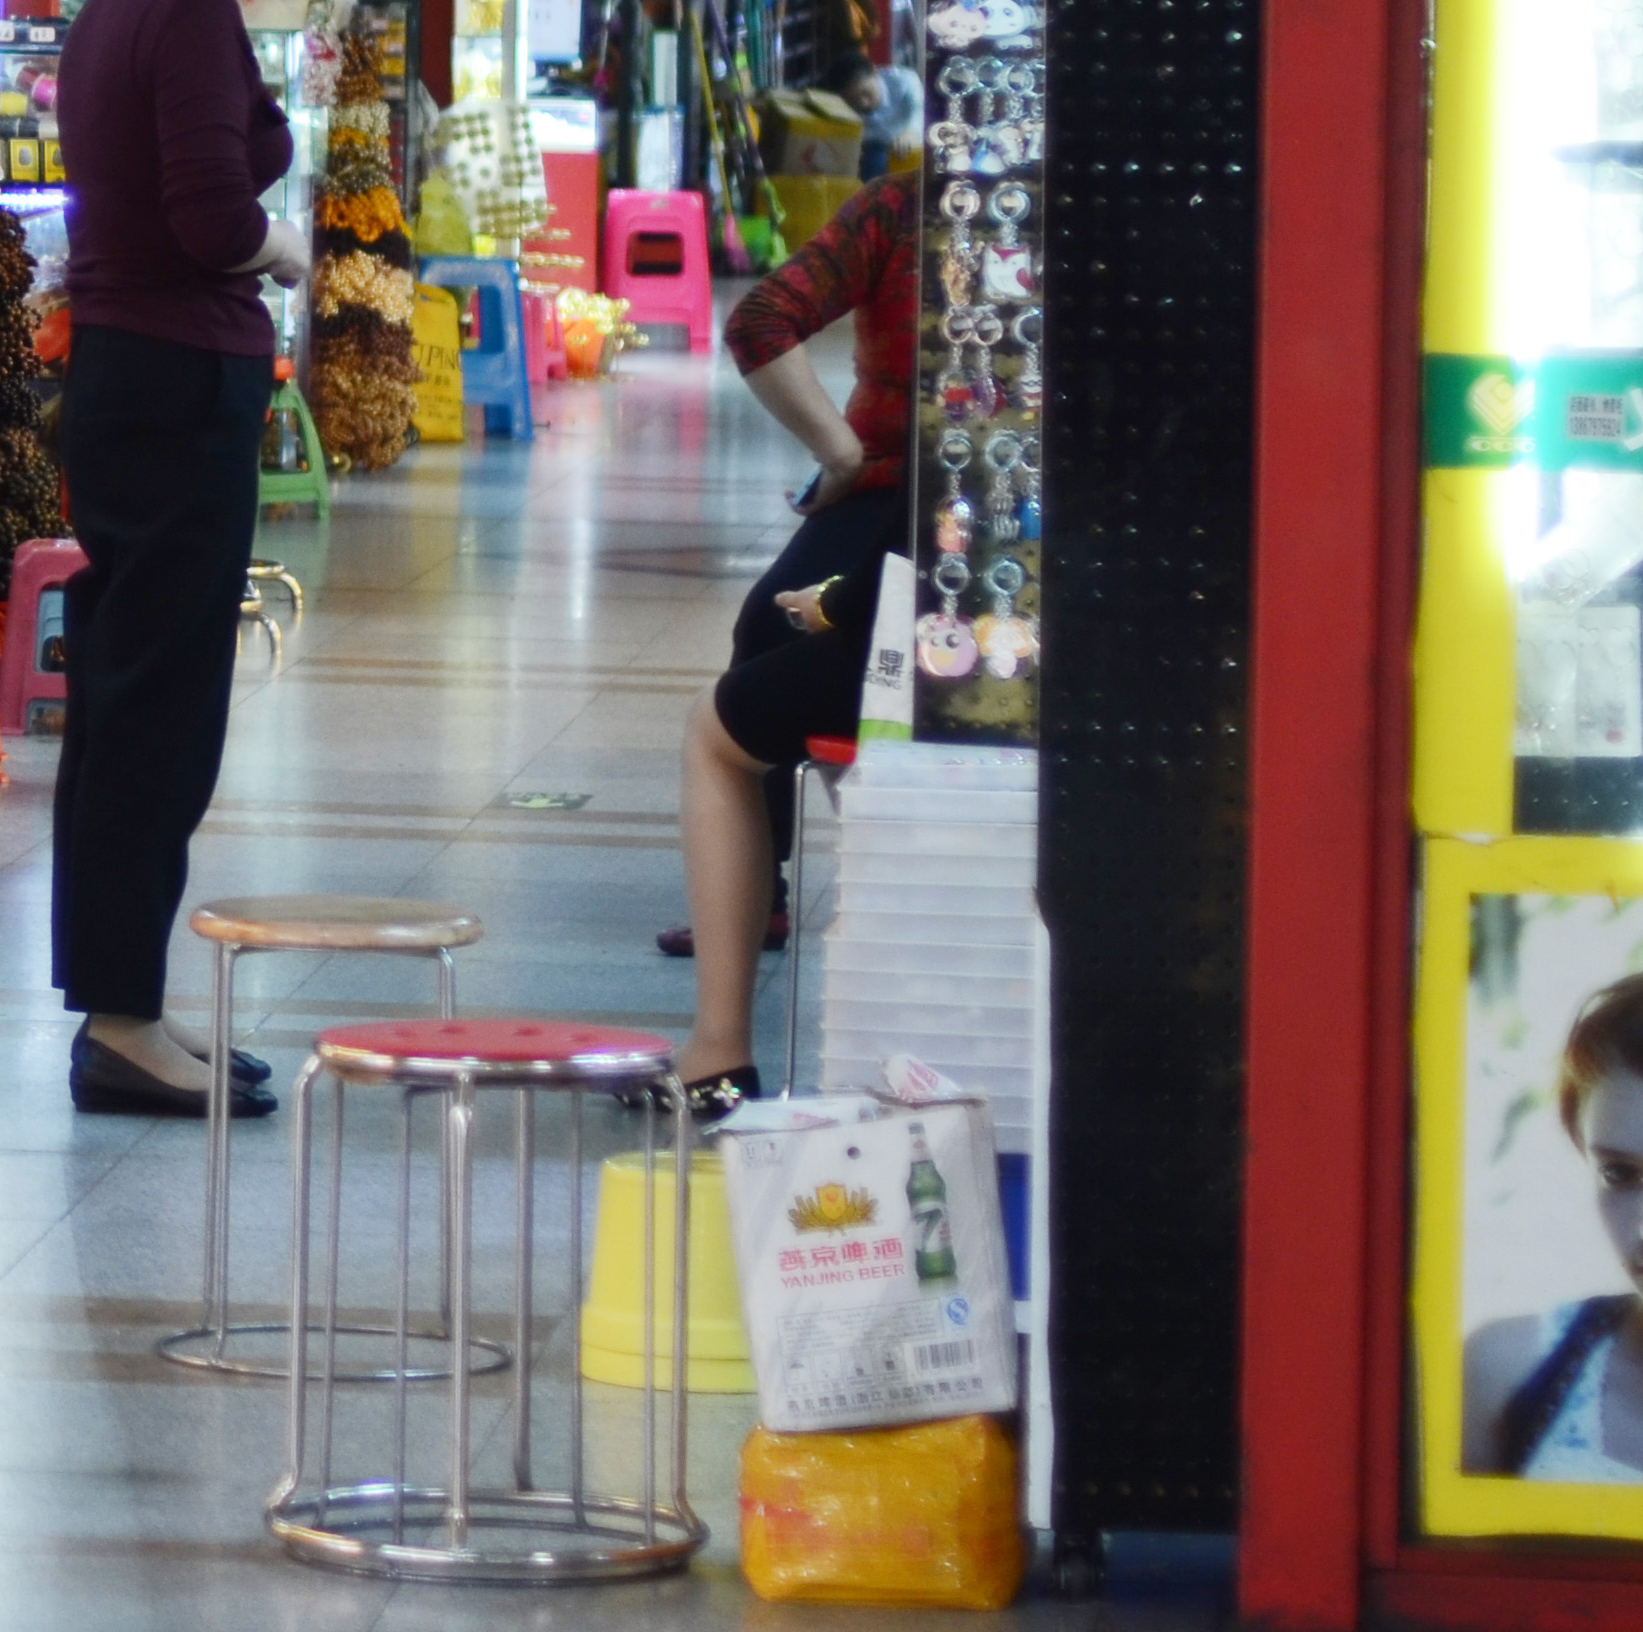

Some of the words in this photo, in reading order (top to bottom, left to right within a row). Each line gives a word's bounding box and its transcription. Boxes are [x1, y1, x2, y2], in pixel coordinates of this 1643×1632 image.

[779, 1237, 903, 1272] 燕京啤酒
[781, 1270, 854, 1289] YANJING
[858, 1263, 906, 1281] BEER
